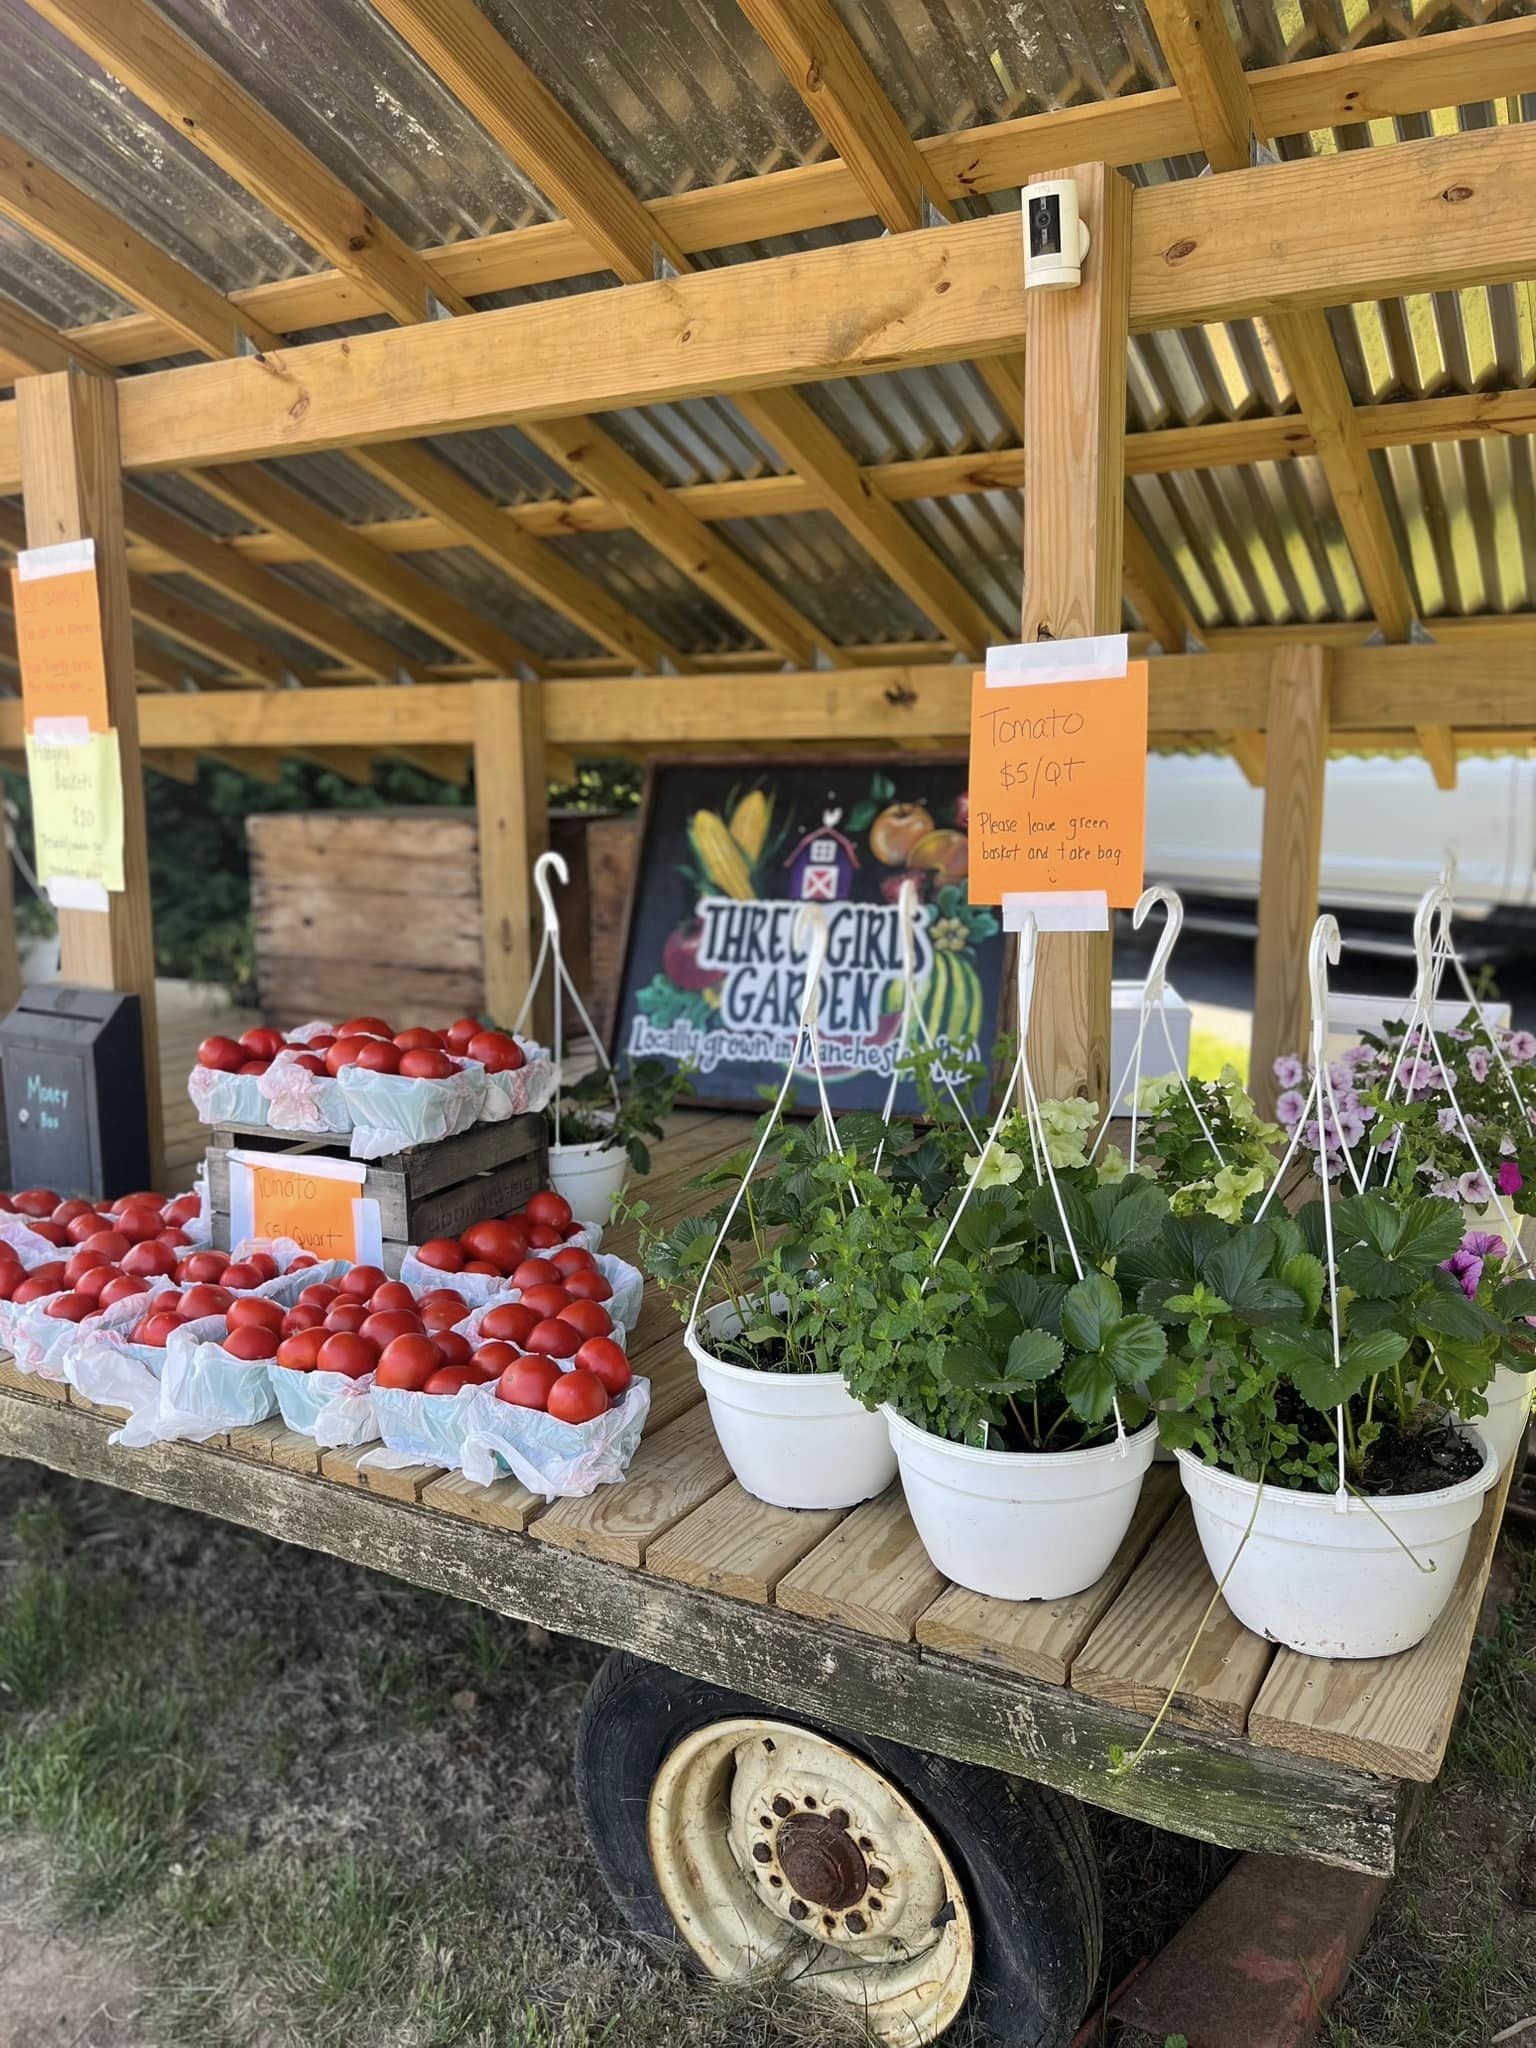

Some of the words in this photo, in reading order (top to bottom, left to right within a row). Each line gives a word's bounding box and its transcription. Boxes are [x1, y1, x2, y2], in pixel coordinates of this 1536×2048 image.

[979, 706, 1084, 747] Tomato
[977, 812, 1017, 835] Please
[1028, 812, 1056, 836] leave
[1066, 817, 1108, 840] green
[982, 842, 1020, 860] basket
[1028, 846, 1048, 860] and
[1098, 845, 1121, 866] bag
[634, 1022, 700, 1064] Locally
[703, 1033, 768, 1066] grown
[775, 1038, 792, 1058] in
[253, 1167, 316, 1201] Tomato
